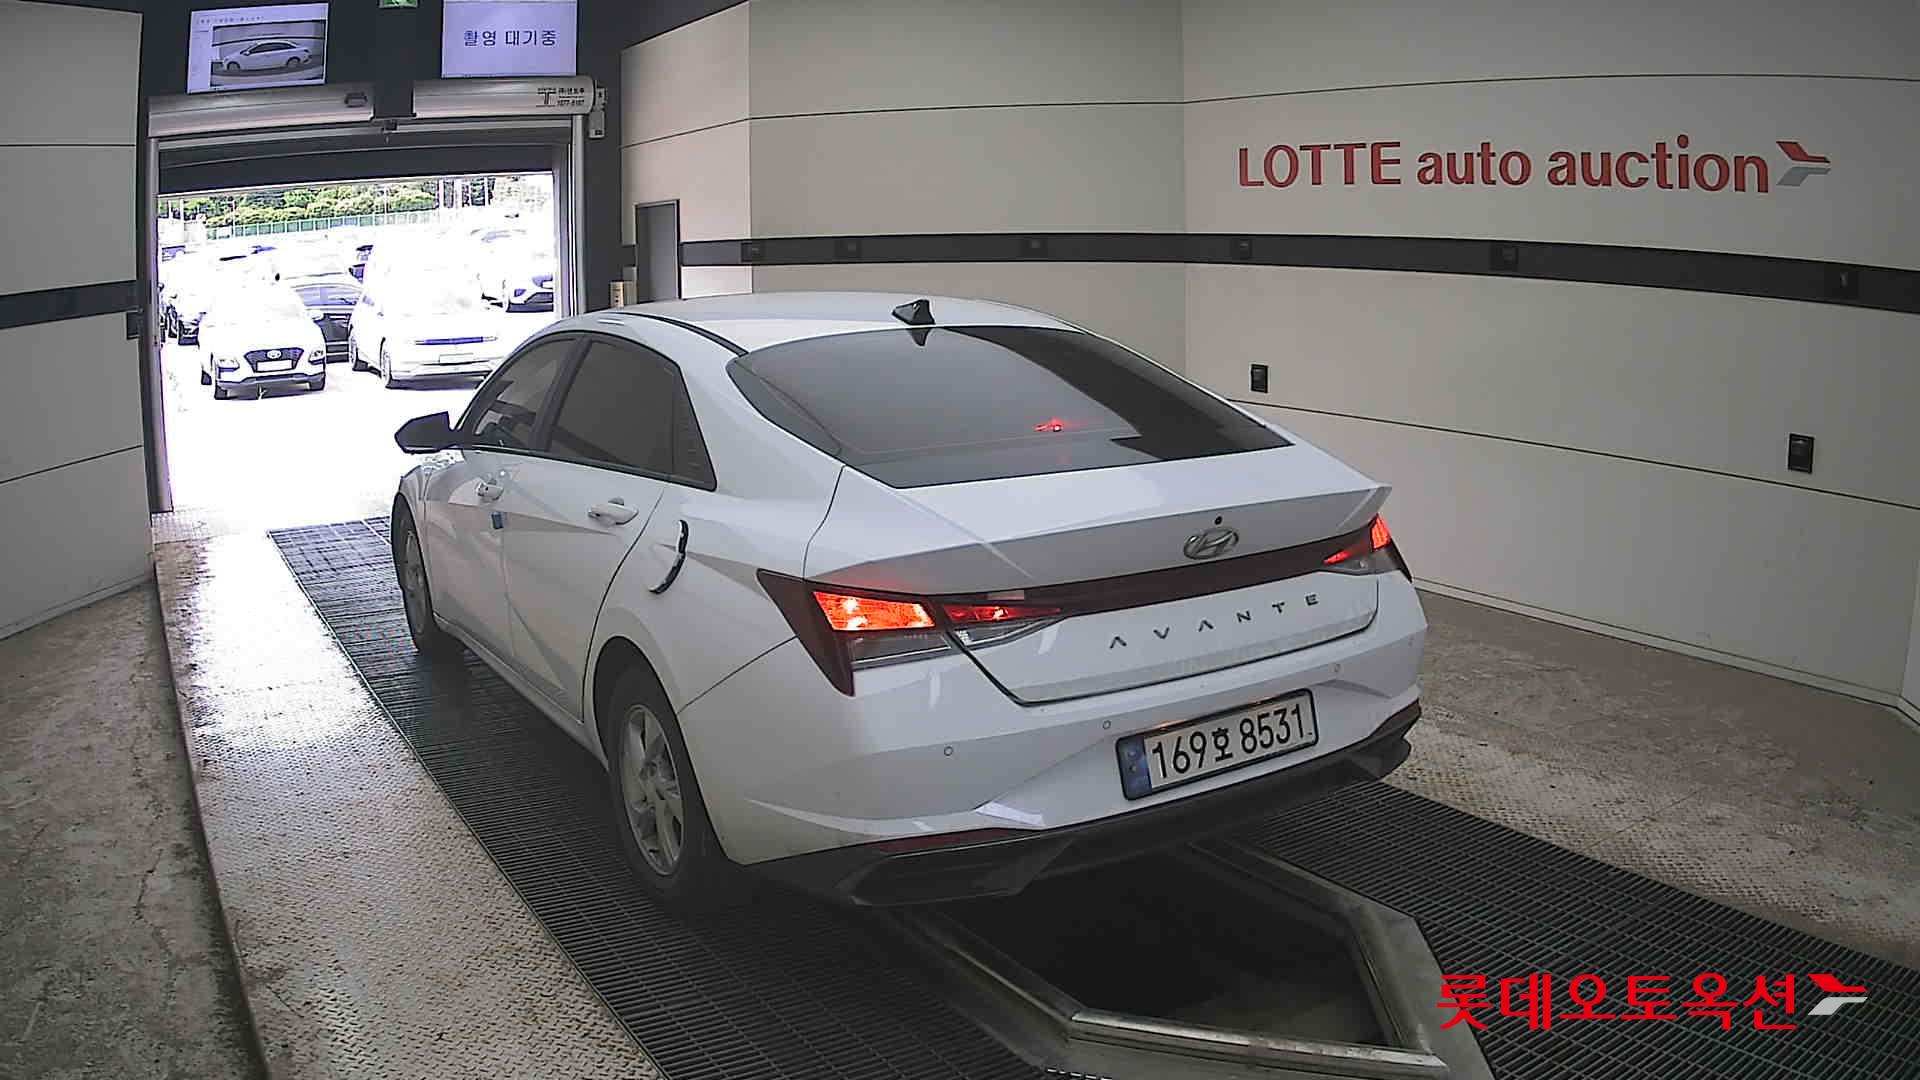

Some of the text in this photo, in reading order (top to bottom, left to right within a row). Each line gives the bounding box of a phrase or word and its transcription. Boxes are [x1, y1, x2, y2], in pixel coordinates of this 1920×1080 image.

[464, 30, 557, 47] 촬영 대기중
[1238, 134, 1769, 193] LOTTE auto auction
[1108, 593, 1319, 650] AVANTE
[1151, 703, 1305, 779] 169호 8531
